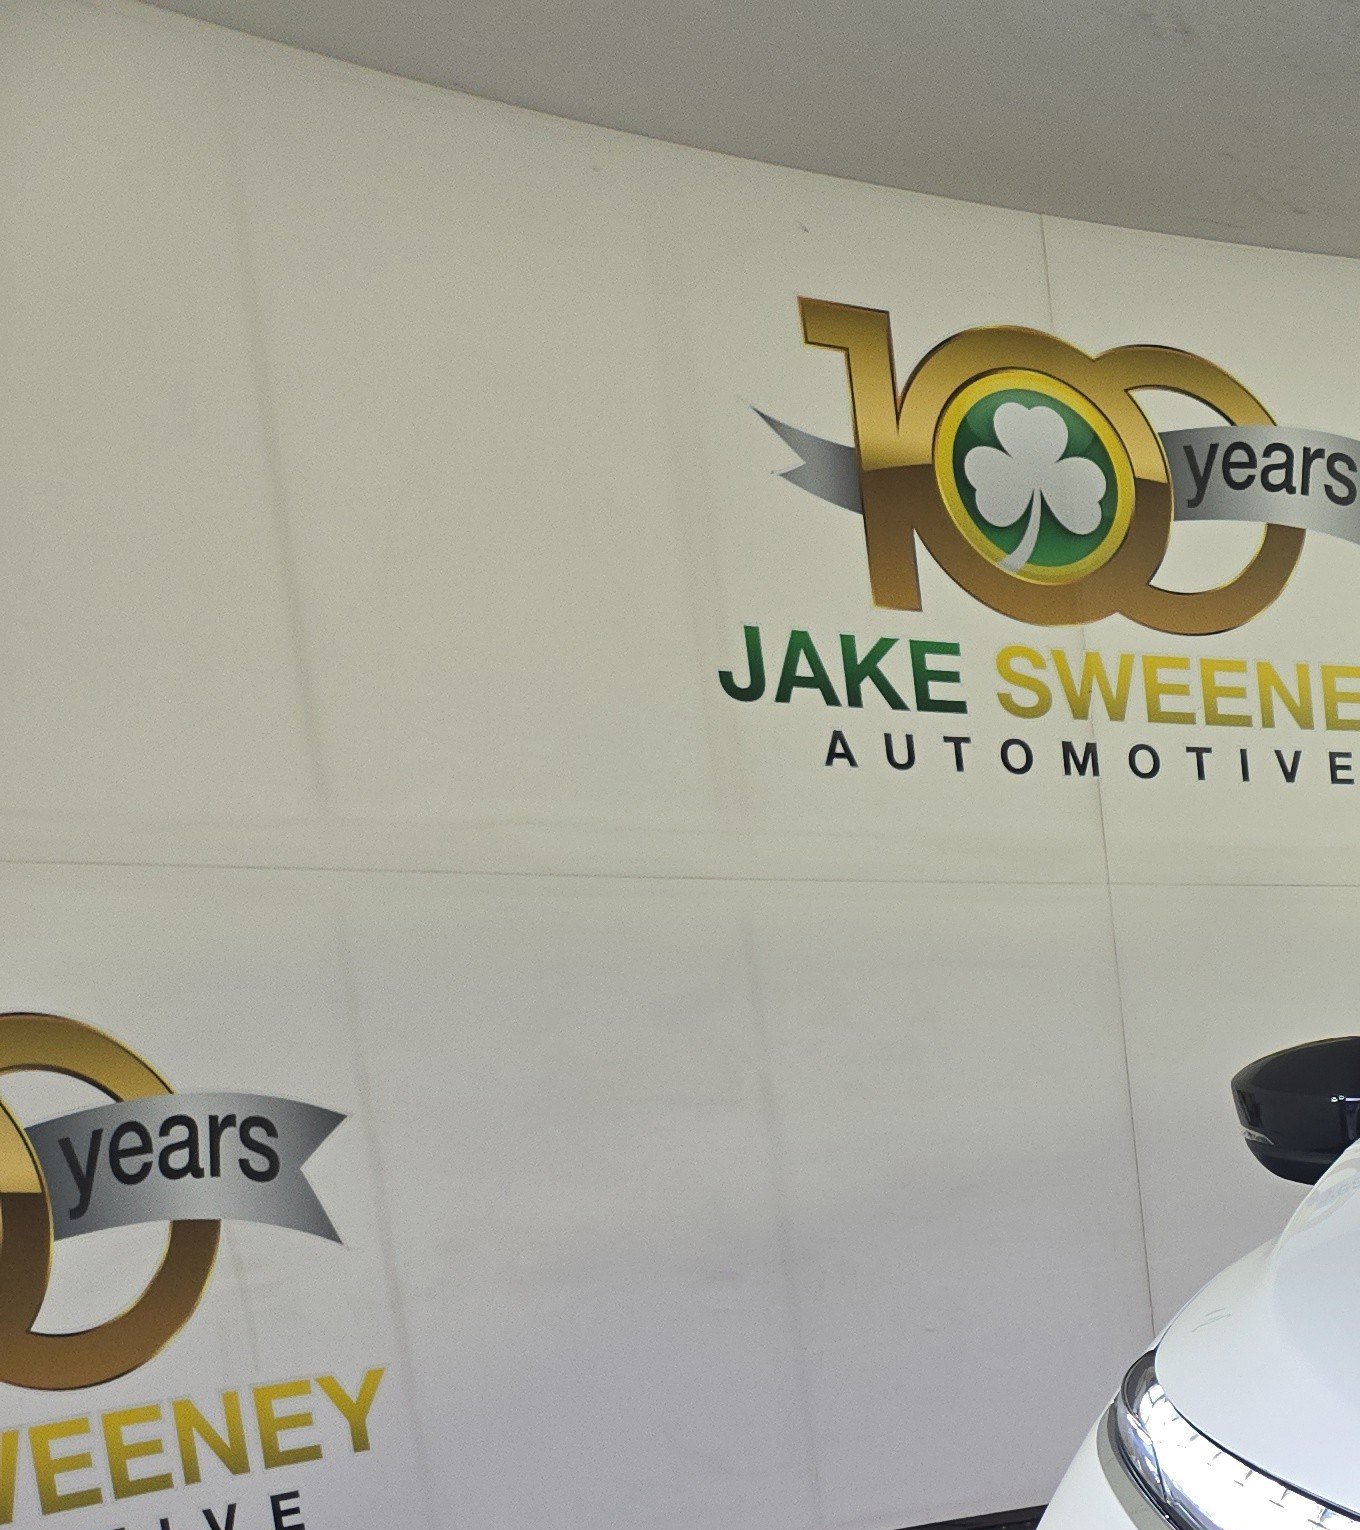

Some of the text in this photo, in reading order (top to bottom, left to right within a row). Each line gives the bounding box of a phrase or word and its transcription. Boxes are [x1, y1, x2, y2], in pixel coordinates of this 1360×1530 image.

[797, 296, 1360, 636] 100 years
[718, 625, 969, 715] JAKE
[825, 730, 1356, 786] AUTOMOTIVE
[57, 1112, 281, 1220] years
[0, 1367, 385, 1525] EENEY
